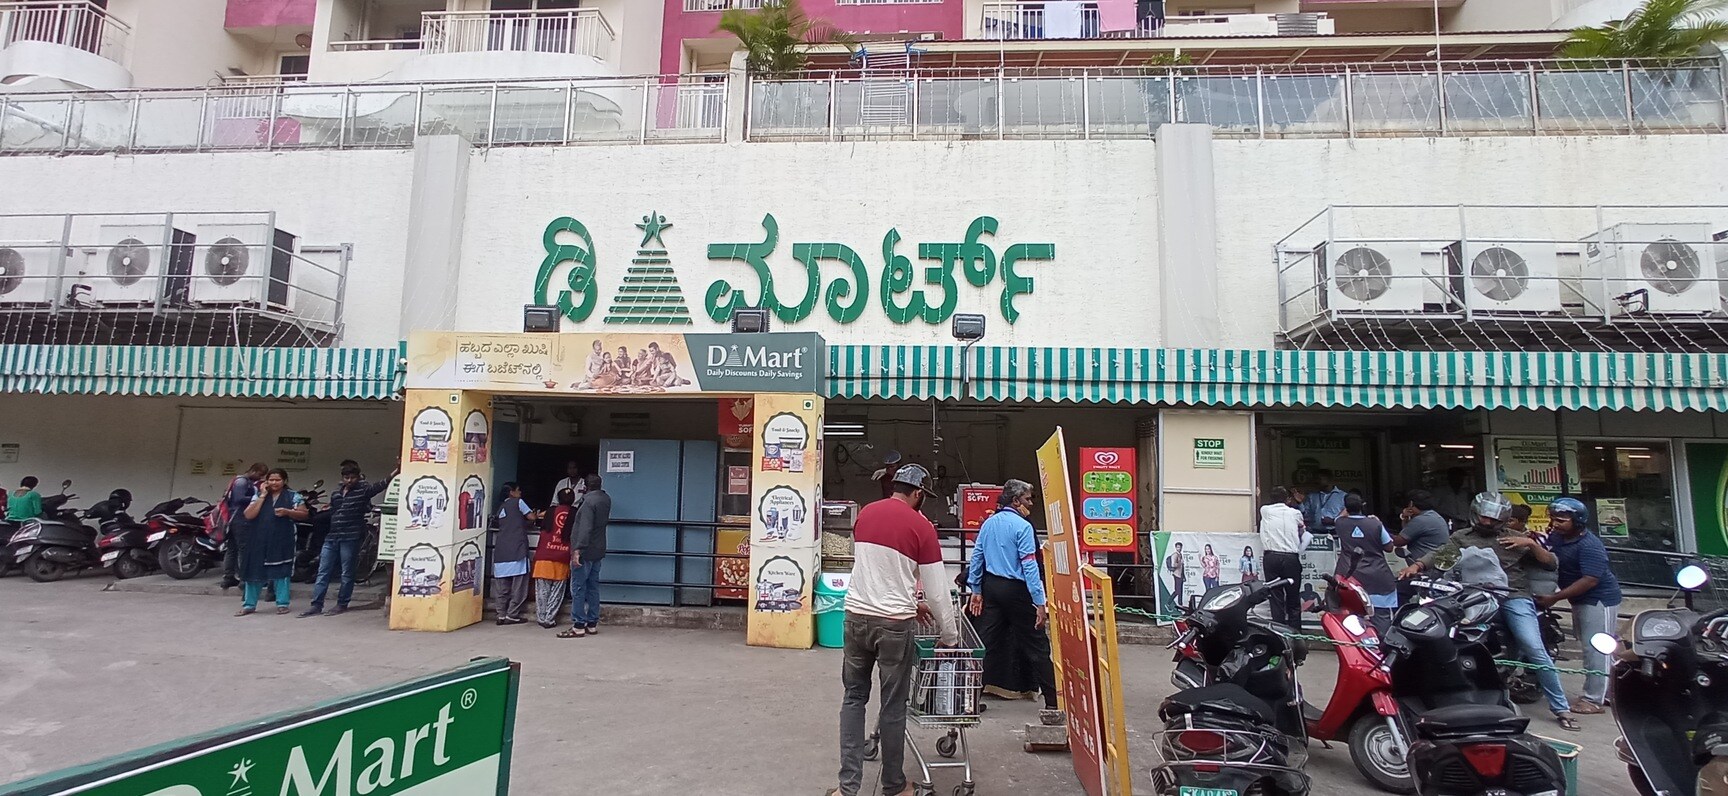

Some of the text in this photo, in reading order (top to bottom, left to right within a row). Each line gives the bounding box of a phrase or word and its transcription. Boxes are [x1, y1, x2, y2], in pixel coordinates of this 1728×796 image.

[460, 341, 548, 359] ಹಬ್ಬದ ಎಲ್ಲಾ ಖುಷಿ
[463, 361, 485, 374] ಈಗ
[707, 369, 803, 380] Daily Discounts Daily Savings
[546, 541, 569, 551] Service
